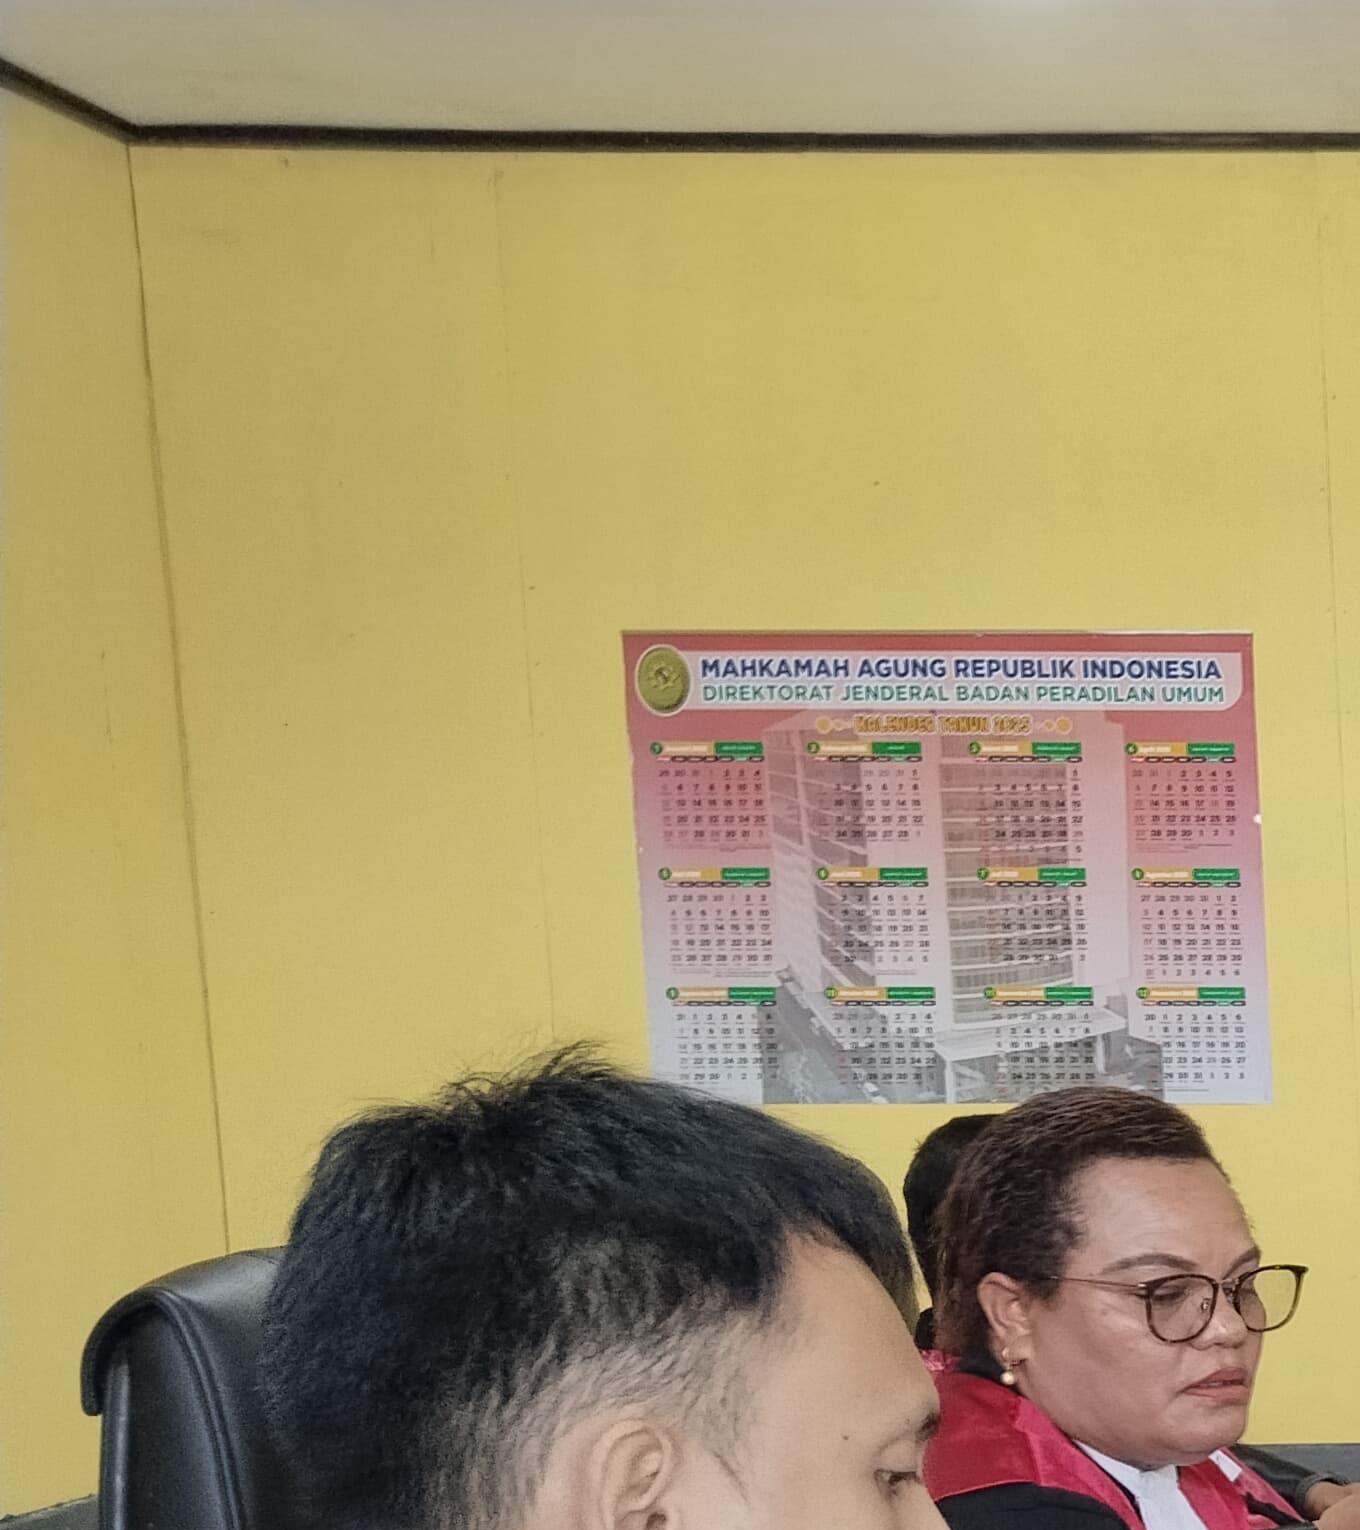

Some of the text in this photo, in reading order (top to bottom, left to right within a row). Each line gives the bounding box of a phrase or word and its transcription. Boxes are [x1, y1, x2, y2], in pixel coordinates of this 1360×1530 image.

[701, 659, 1222, 678] MAHKAMAH AGUNG REPUBLIK INDONESIA
[703, 685, 1224, 702] DIREKTORAT JENDERAL BADAN PERADILAN UMUM
